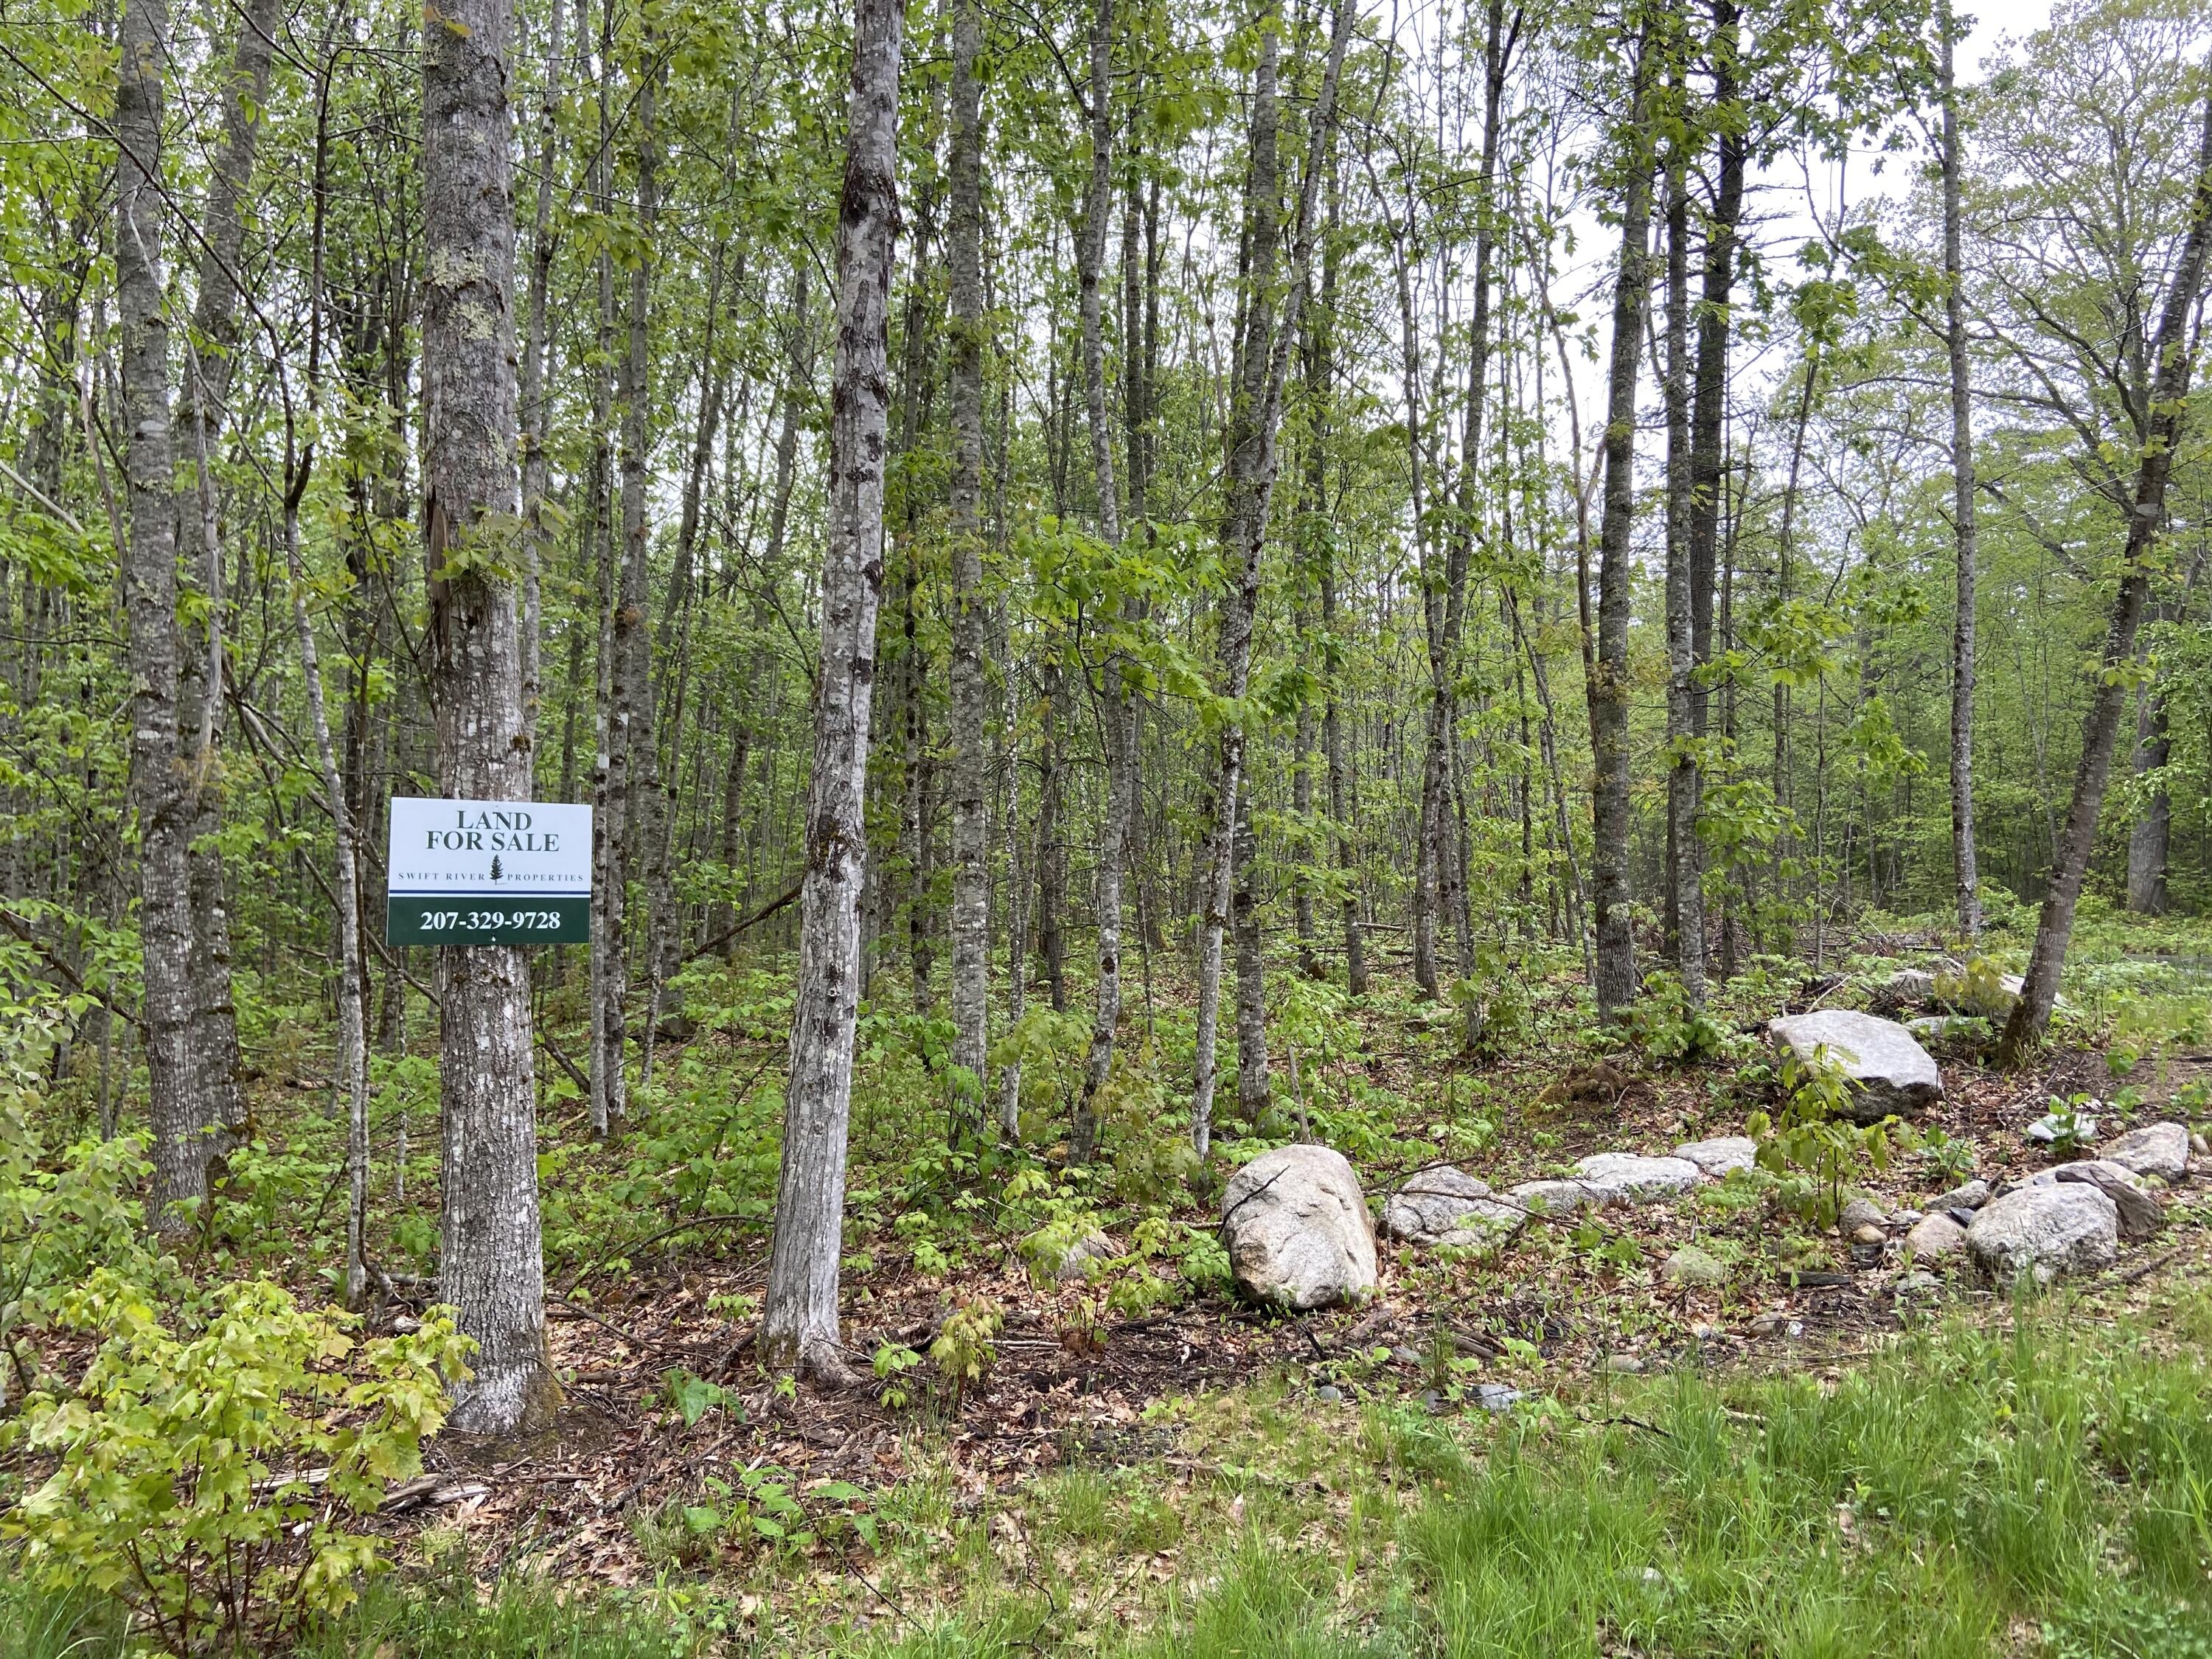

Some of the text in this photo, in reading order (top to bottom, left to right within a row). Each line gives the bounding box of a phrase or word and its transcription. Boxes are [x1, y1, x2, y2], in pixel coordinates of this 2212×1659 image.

[456, 810, 532, 830] LAND
[426, 831, 560, 852] FOR SALE
[398, 872, 584, 882] SWIFT RIVER PROPERTIES
[420, 911, 561, 931] 207-329-9728
